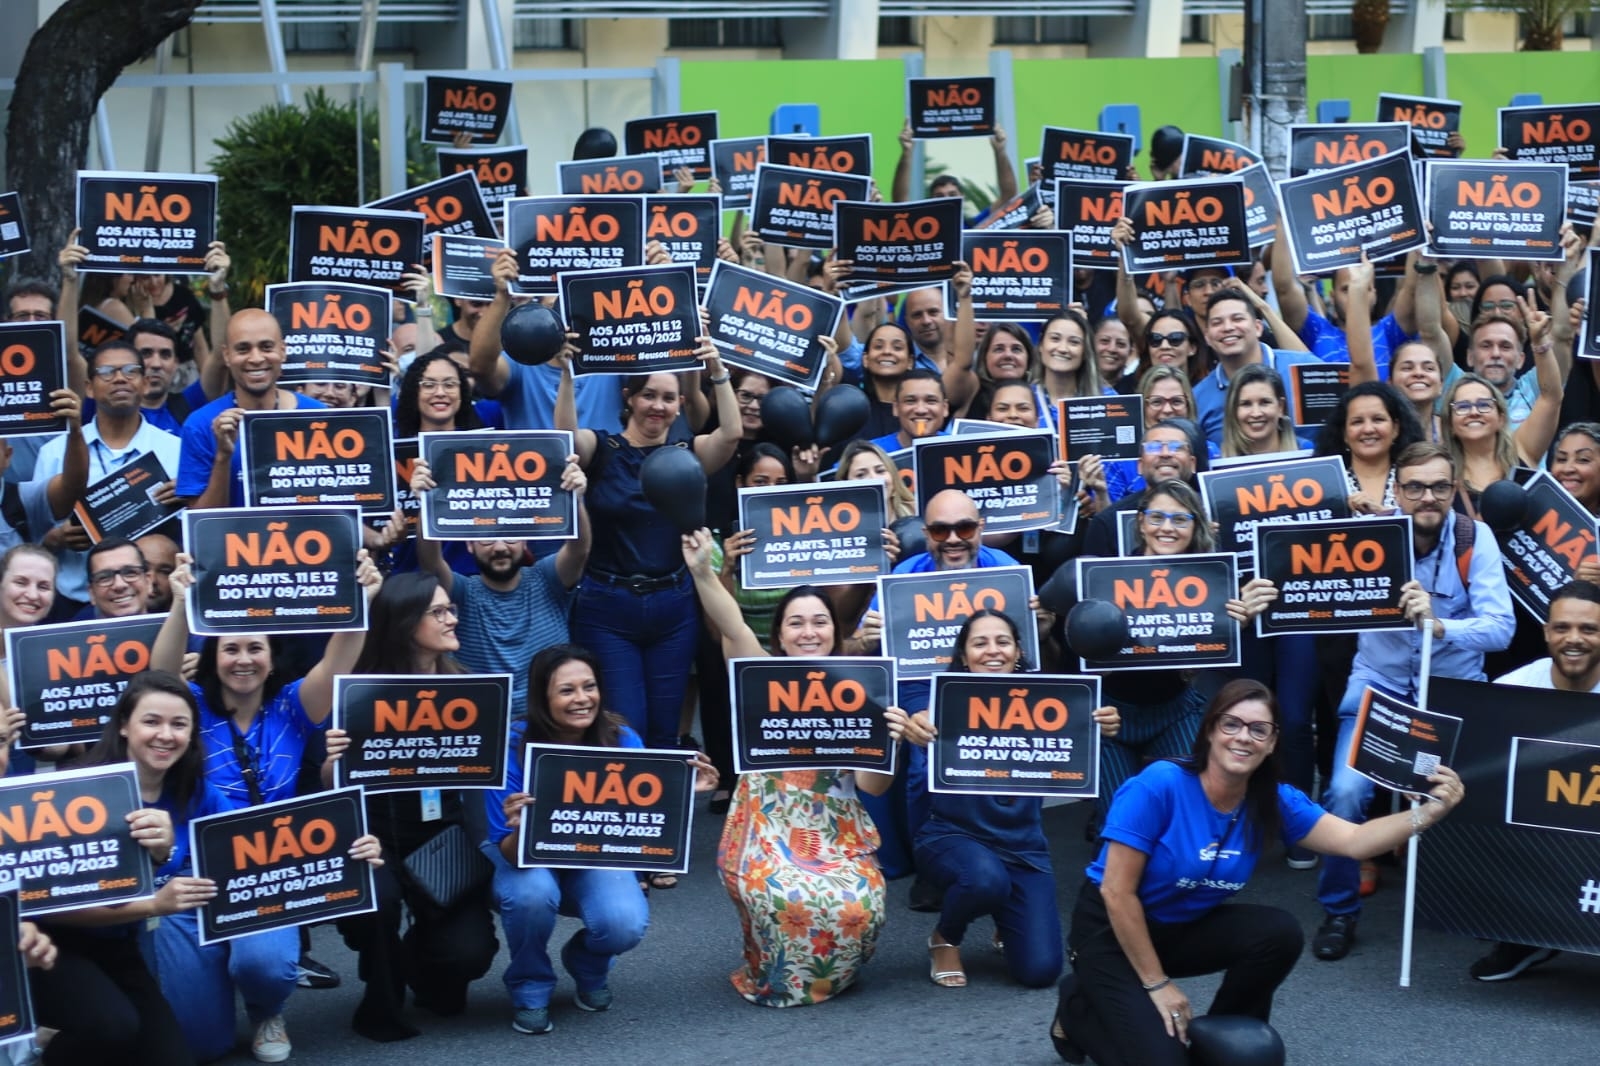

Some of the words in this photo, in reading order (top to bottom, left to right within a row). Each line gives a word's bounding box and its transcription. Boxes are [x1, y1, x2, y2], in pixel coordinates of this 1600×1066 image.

[444, 85, 496, 111] NÃO
[927, 84, 980, 106] NÃO
[1394, 104, 1447, 129] NÃO
[1522, 114, 1591, 145] NÃO
[644, 122, 700, 148] NÃO
[1314, 134, 1388, 164] NÃO
[789, 146, 854, 172] NÃO
[1060, 139, 1116, 164] NÃO
[1202, 149, 1254, 171] NÃO
[581, 166, 644, 194] NÃO
[778, 179, 845, 210] NÃO
[1457, 175, 1540, 207] NÃO
[105, 186, 191, 222] NÃO
[413, 195, 463, 227] ÃO
[1080, 191, 1123, 222] NÃ
[1144, 191, 1223, 226] NÃO
[1311, 175, 1395, 220] NÃO
[95, 226, 122, 235] AOS
[124, 226, 158, 236] ARTS.
[160, 228, 170, 237] 11
[173, 228, 181, 237] E
[183, 228, 195, 238] 12
[537, 207, 619, 241] NÃO
[648, 206, 697, 237] ÃO
[863, 212, 941, 241] NÃO
[1448, 211, 1473, 219] AOS
[1475, 211, 1508, 221] ARTS.
[1510, 213, 1519, 221] 11
[1522, 213, 1530, 221] E
[1532, 213, 1544, 222] 12
[1450, 221, 1468, 230] DO
[1469, 221, 1492, 230] PLV
[1493, 222, 1542, 232] 09/2023
[98, 237, 117, 247] DO
[119, 238, 142, 247] PLV
[143, 238, 193, 249] 09/2023
[319, 220, 401, 255] NÃO
[1140, 230, 1164, 240] AOS
[1165, 228, 1196, 238] ARTS.
[1197, 227, 1206, 235] 11
[1208, 227, 1216, 235] E
[1217, 226, 1229, 234] 12
[1142, 240, 1160, 249] DO
[1161, 239, 1181, 248] PLV
[1183, 236, 1228, 247] 09/2023
[973, 241, 1048, 272] NÃO
[292, 295, 371, 330] NÃO
[592, 279, 677, 319] NÃO
[732, 285, 812, 330] NÃO
[589, 325, 615, 336] AOS
[617, 323, 649, 334] ARTS.
[650, 322, 659, 331] 11
[662, 321, 670, 331] E
[671, 320, 683, 330] 12
[592, 337, 611, 347] DO
[612, 335, 634, 346] PLV
[635, 332, 682, 344] 09/2023
[274, 421, 364, 460] NÃO
[455, 444, 546, 482] NÃO
[943, 445, 1032, 484] NÃO
[1235, 474, 1324, 515] NÃO
[771, 496, 860, 535] NÃO
[225, 522, 331, 566] NÃO
[1291, 533, 1385, 574] NÃO
[1532, 508, 1598, 570] NÃ
[216, 573, 248, 585] AOS
[251, 572, 293, 584] ARTS.
[294, 572, 306, 583] 11
[310, 572, 320, 583] E
[323, 571, 338, 582] 12
[219, 587, 242, 599] DO
[244, 587, 272, 598] PLV
[274, 585, 336, 598] 09/2023
[1114, 568, 1207, 609] NÃO
[1282, 580, 1311, 591] AOS
[1313, 578, 1350, 589] ARTS.
[1352, 578, 1362, 588] 11
[1366, 577, 1375, 587] E
[1377, 577, 1390, 587] 12
[914, 582, 1006, 622] NÃO
[1285, 592, 1305, 603] DO
[1307, 591, 1332, 602] PLV
[1334, 589, 1388, 601] 09/2023
[47, 634, 149, 681] NÃO
[766, 671, 866, 711] NÃO
[373, 690, 478, 731] NÃO
[760, 718, 790, 727] AOS
[792, 717, 830, 727] ARTS.
[832, 717, 843, 727] 11
[846, 718, 855, 727] E
[858, 718, 871, 727] 12
[968, 689, 1068, 731] NÃO
[361, 737, 394, 748] AOS
[396, 736, 437, 747] ARTS.
[439, 735, 450, 745] 11
[454, 735, 464, 745] E
[466, 735, 481, 745] 12
[763, 730, 784, 739] DO
[786, 730, 812, 739] PLV
[813, 729, 869, 740] 09/2023
[957, 735, 988, 746] AOS
[990, 736, 1029, 747] ARTS.
[1032, 737, 1042, 748] 11
[1046, 738, 1056, 748] E
[1058, 738, 1072, 749] 12
[364, 750, 387, 760] DO
[388, 749, 416, 759] PLV
[417, 747, 478, 759] 09/2023
[959, 748, 981, 759] DO
[983, 749, 1010, 760] PLV
[1011, 750, 1070, 762] 09/2023
[562, 763, 662, 806] NÃO
[1547, 765, 1600, 806] NÃ
[0, 790, 108, 845] NÃO
[550, 809, 581, 820] AOS
[582, 810, 622, 822] ARTS.
[625, 812, 635, 823] 11
[638, 813, 648, 823] E
[650, 813, 665, 824] 12
[551, 822, 573, 833] DO
[575, 823, 602, 834] PLV
[603, 825, 661, 837] 09/2023
[19, 845, 70, 865] ARTS.
[70, 843, 87, 857] 11
[87, 842, 100, 855] E
[100, 838, 119, 853] 12
[232, 814, 336, 870] NÃO
[14, 864, 45, 880] PLV
[47, 854, 119, 876] 09/2023
[226, 873, 257, 890] AOS
[260, 865, 300, 883] ARTS.
[302, 862, 313, 874] 11
[316, 859, 327, 872] E
[329, 856, 344, 869] 12
[230, 888, 252, 903] DO
[254, 882, 281, 898] PLV
[283, 870, 342, 892] 09/2023
